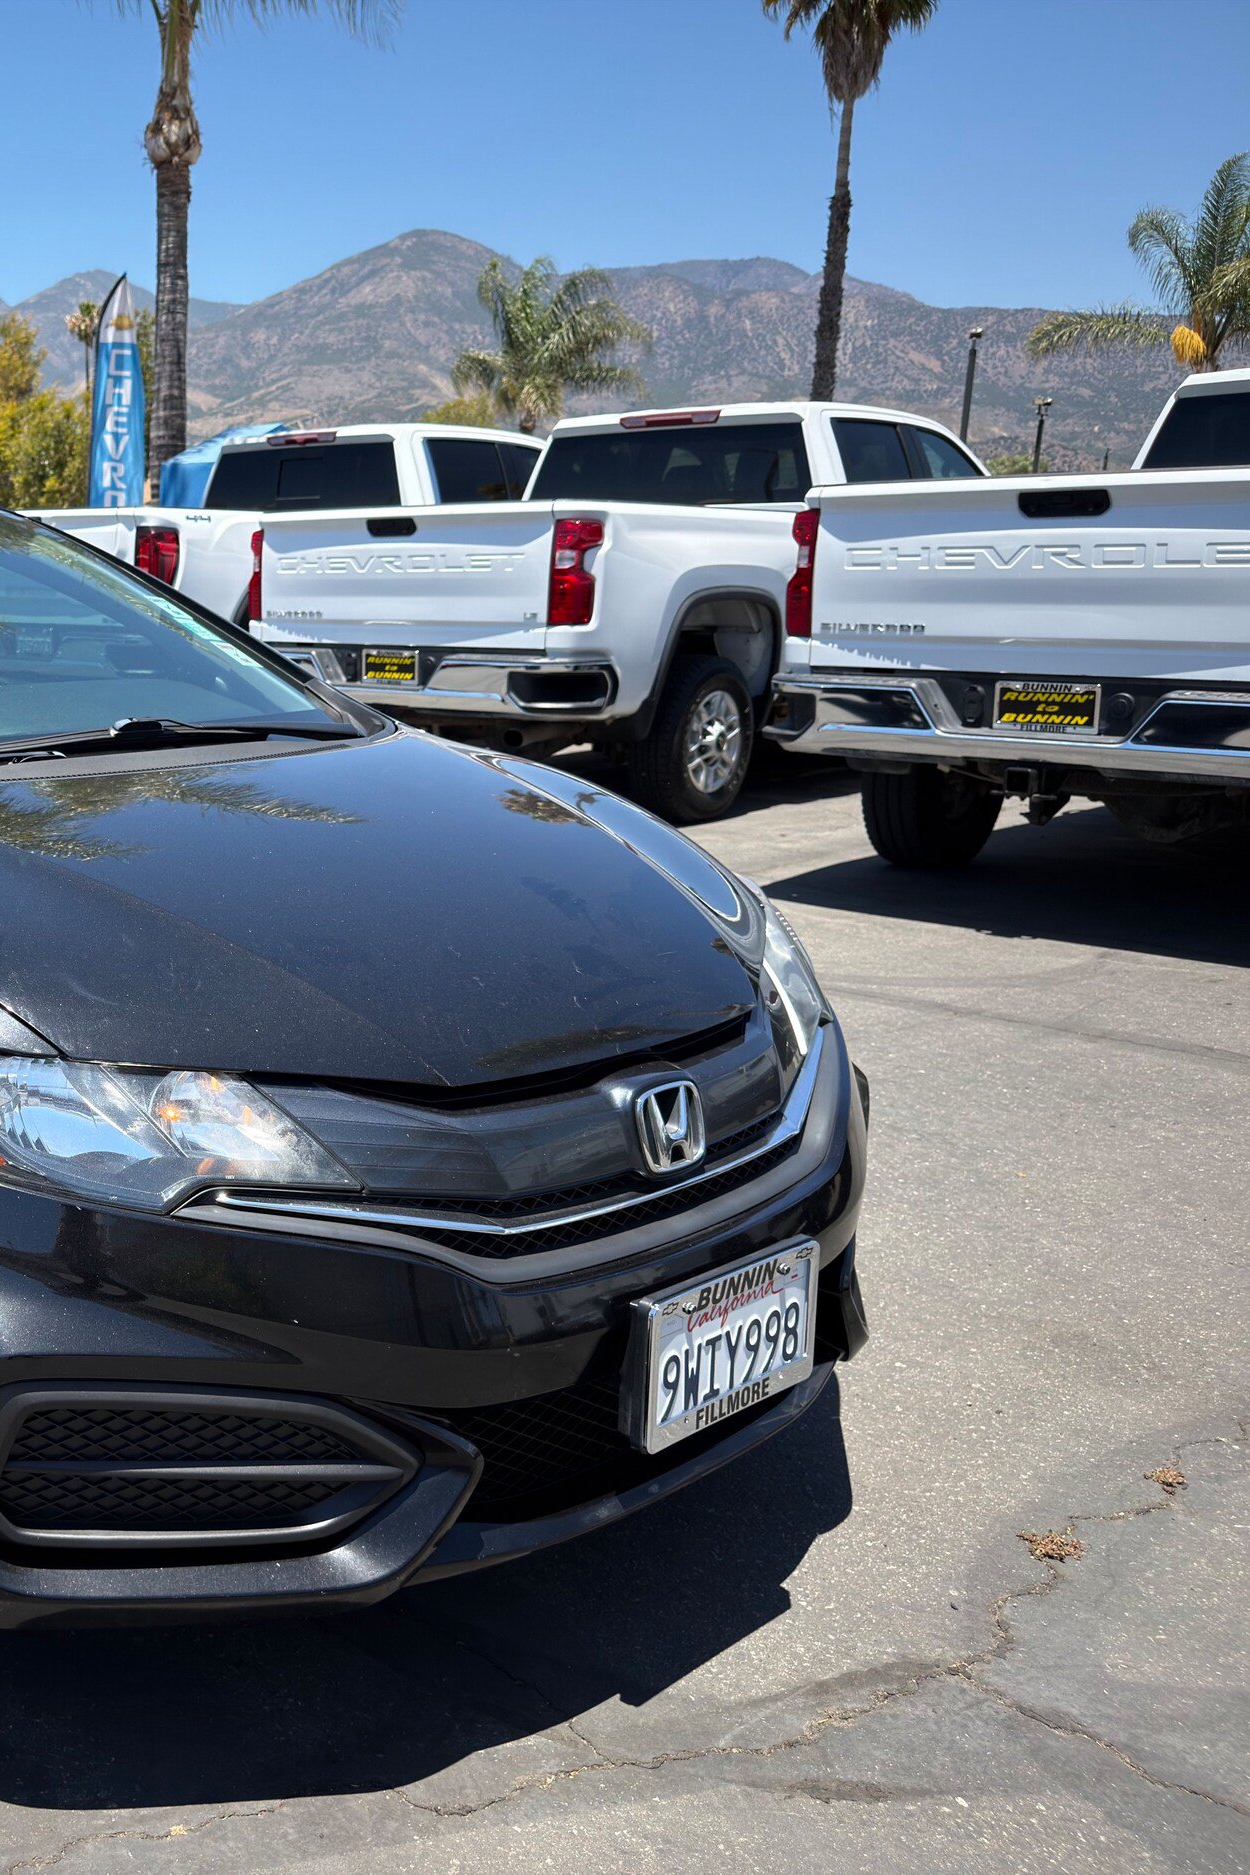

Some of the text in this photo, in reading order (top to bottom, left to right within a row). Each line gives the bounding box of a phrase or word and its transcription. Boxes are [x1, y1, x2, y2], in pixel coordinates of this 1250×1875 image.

[275, 553, 525, 575] CHEVROLET
[820, 622, 926, 635] SILVERADO
[366, 671, 413, 680] BUNNIN
[1022, 682, 1073, 692] BUNNIN
[1002, 691, 1095, 704] RUNNIN'
[1036, 703, 1060, 712] to
[1000, 712, 1090, 726] BUNNIN
[1020, 723, 1068, 734] FILLMORE
[695, 1259, 778, 1313] BUNNIN
[686, 1279, 784, 1333] California
[661, 1301, 800, 1423] 9WIY998
[695, 1377, 770, 1430] FILLMORE
